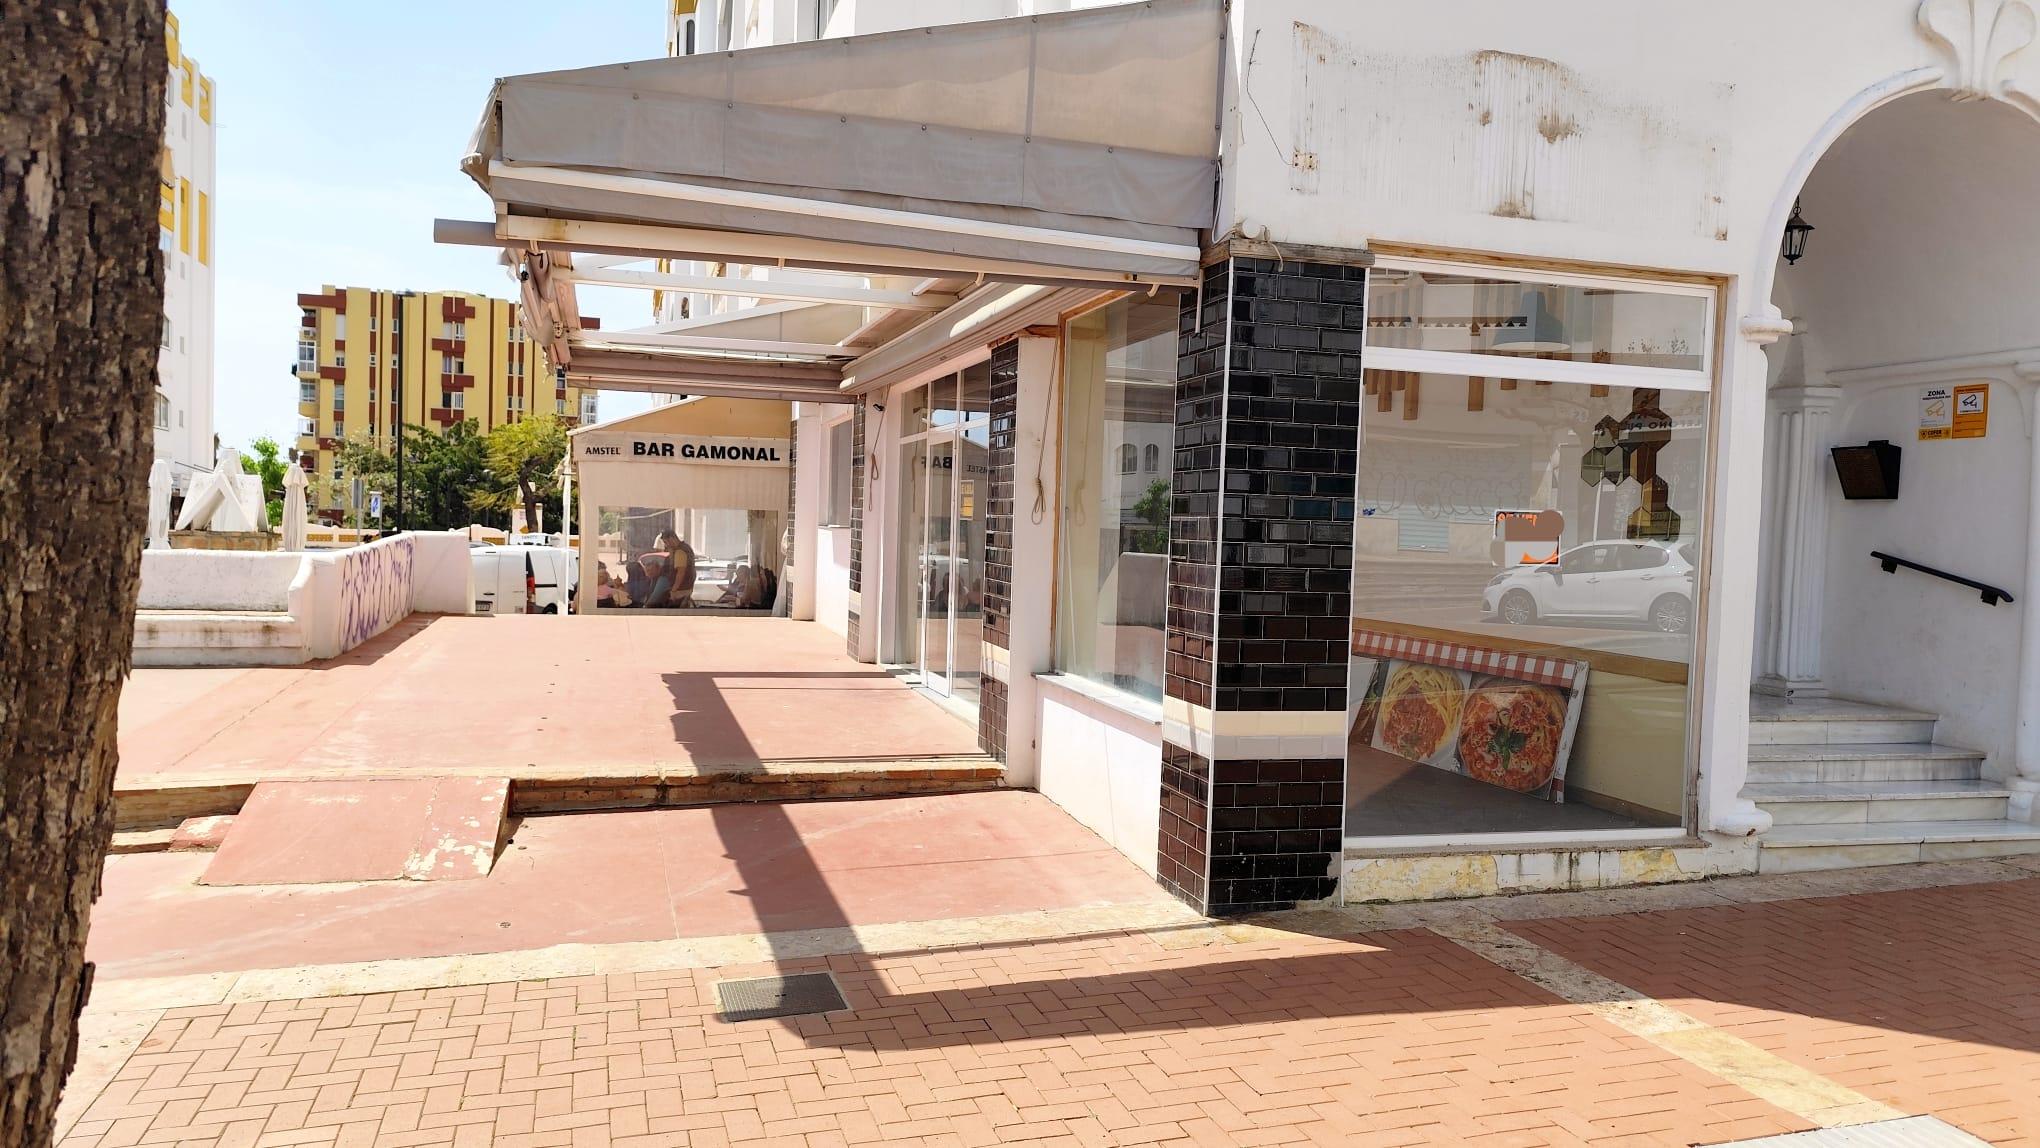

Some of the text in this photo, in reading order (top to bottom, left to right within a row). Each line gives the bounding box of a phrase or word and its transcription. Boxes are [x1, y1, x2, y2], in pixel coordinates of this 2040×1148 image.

[585, 442, 781, 461] AMSTEL BAR GAMONAL
